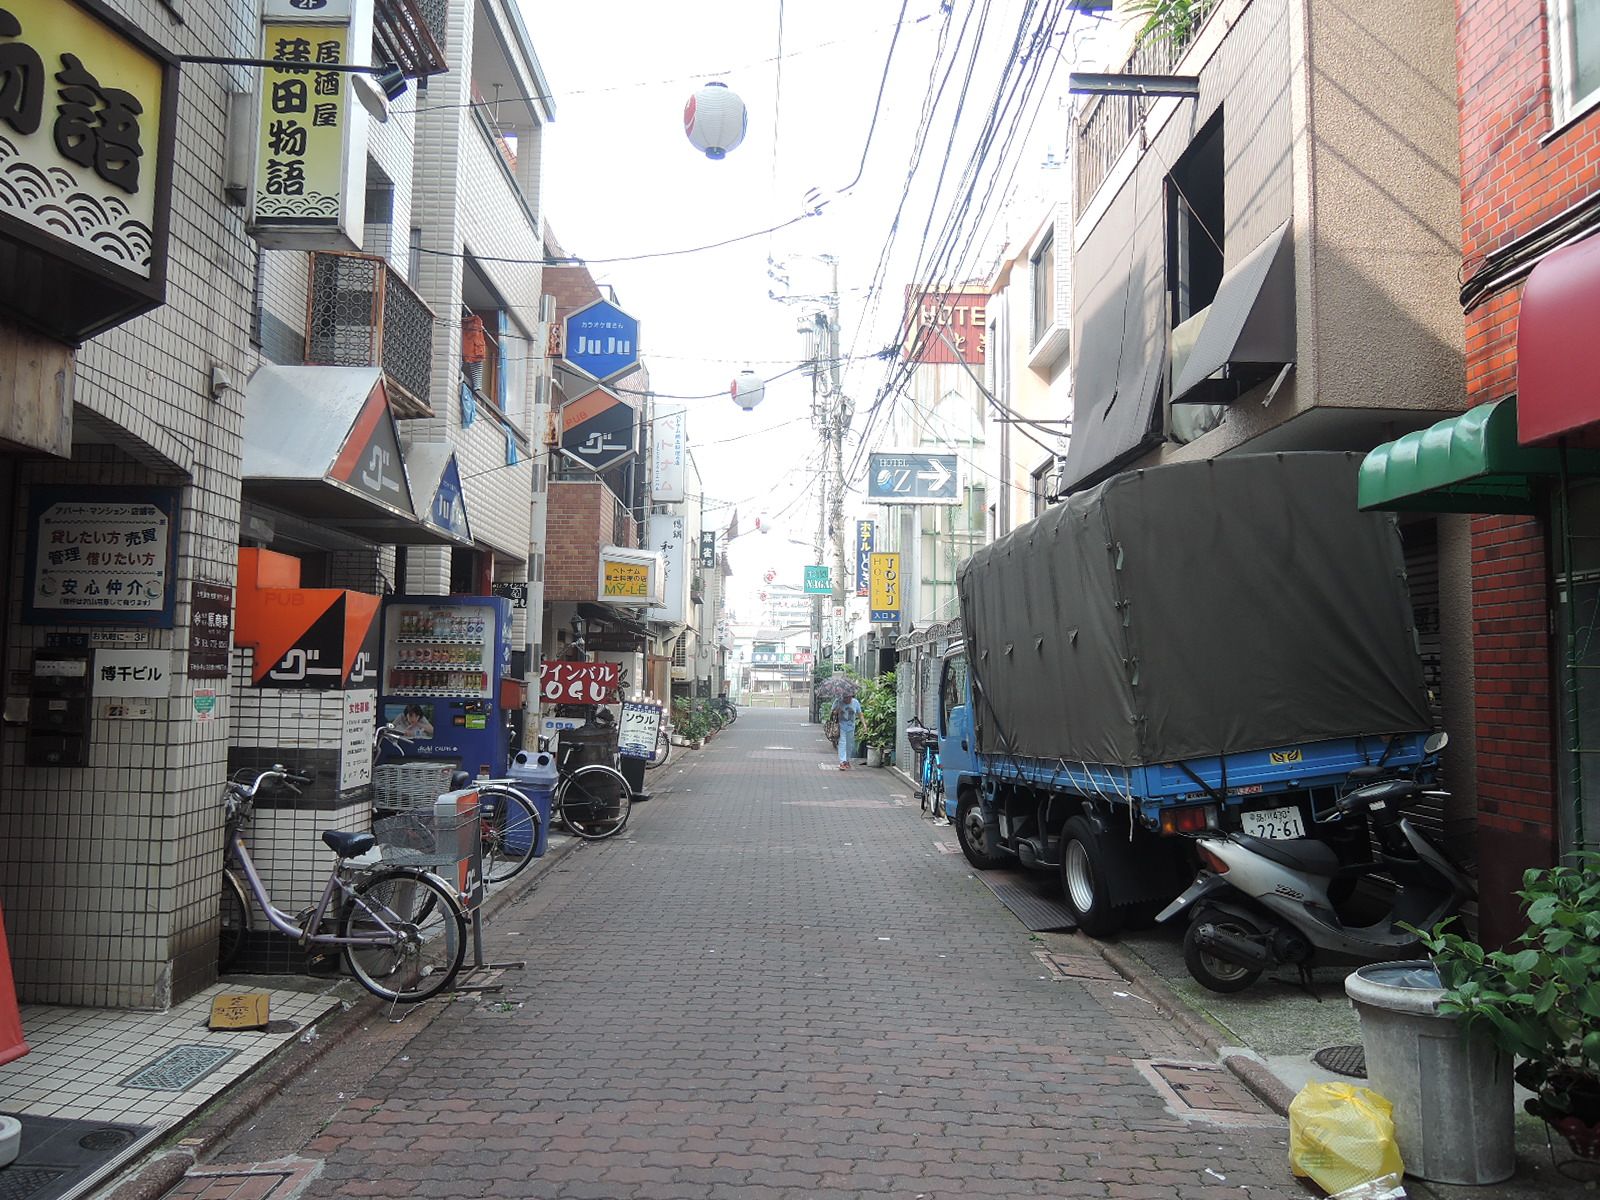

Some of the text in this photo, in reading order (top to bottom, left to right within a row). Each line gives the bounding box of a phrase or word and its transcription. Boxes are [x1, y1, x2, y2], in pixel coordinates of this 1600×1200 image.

[312, 40, 341, 128] 居酒屋
[266, 38, 310, 196] 蒲田物語
[574, 336, 631, 356] JuJu
[565, 411, 588, 427] PUB
[879, 458, 910, 467] HOTEL
[51, 528, 157, 547] 貸したい方 売買
[48, 546, 155, 566] 管理 借りたい方
[613, 567, 641, 575] ベトナム
[61, 579, 143, 596] 安心仲介
[264, 591, 305, 607] PUB
[134, 633, 146, 641] 3F
[541, 680, 606, 702] OGU
[626, 713, 655, 725] ソウル
